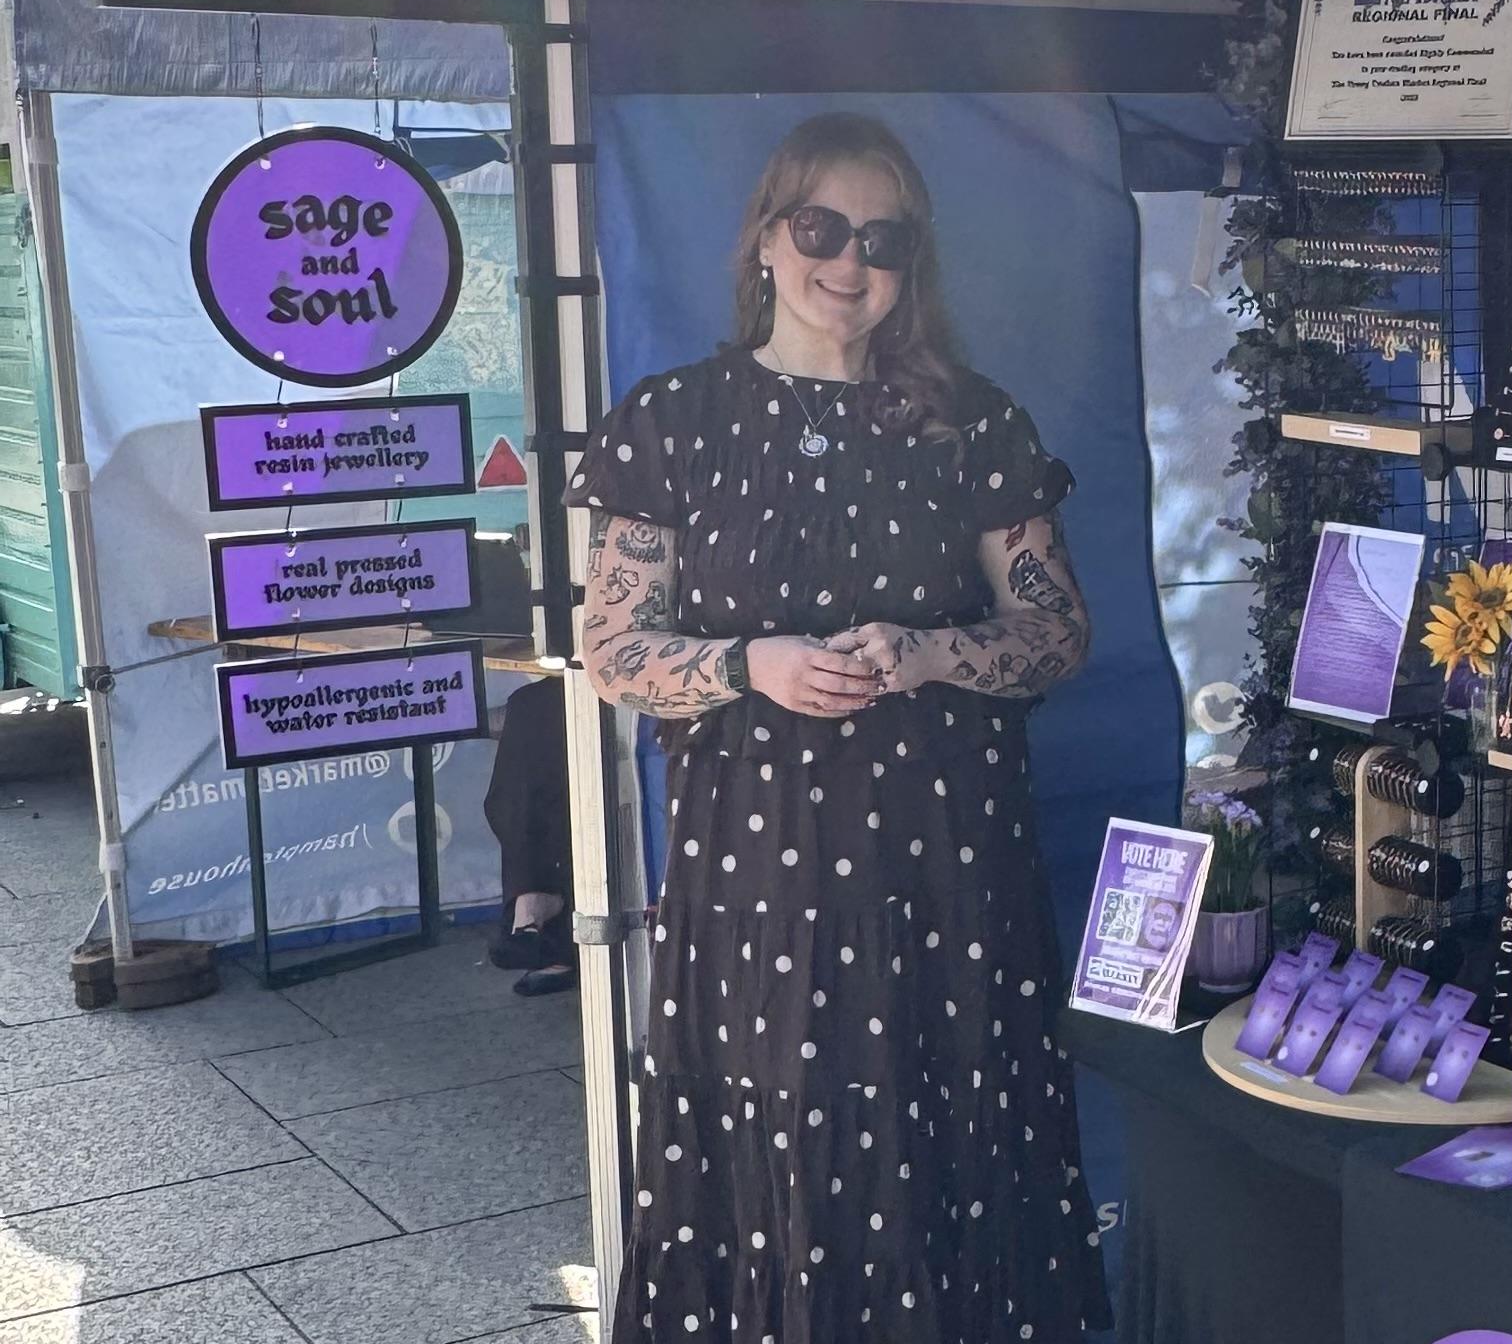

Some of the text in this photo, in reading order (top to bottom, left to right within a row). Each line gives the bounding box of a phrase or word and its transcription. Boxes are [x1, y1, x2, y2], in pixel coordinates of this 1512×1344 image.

[1434, 7, 1479, 21] FINAL
[259, 195, 393, 247] sage
[302, 247, 360, 275] and
[266, 267, 398, 326] soul
[264, 423, 416, 451] hand crafted
[255, 447, 430, 478] resin jewellery
[281, 548, 423, 580] real pressed
[264, 573, 436, 604] flower designs
[243, 670, 464, 719] hypoallergenic and
[266, 695, 447, 734] water resistant
[1121, 840, 1151, 868] VOTE
